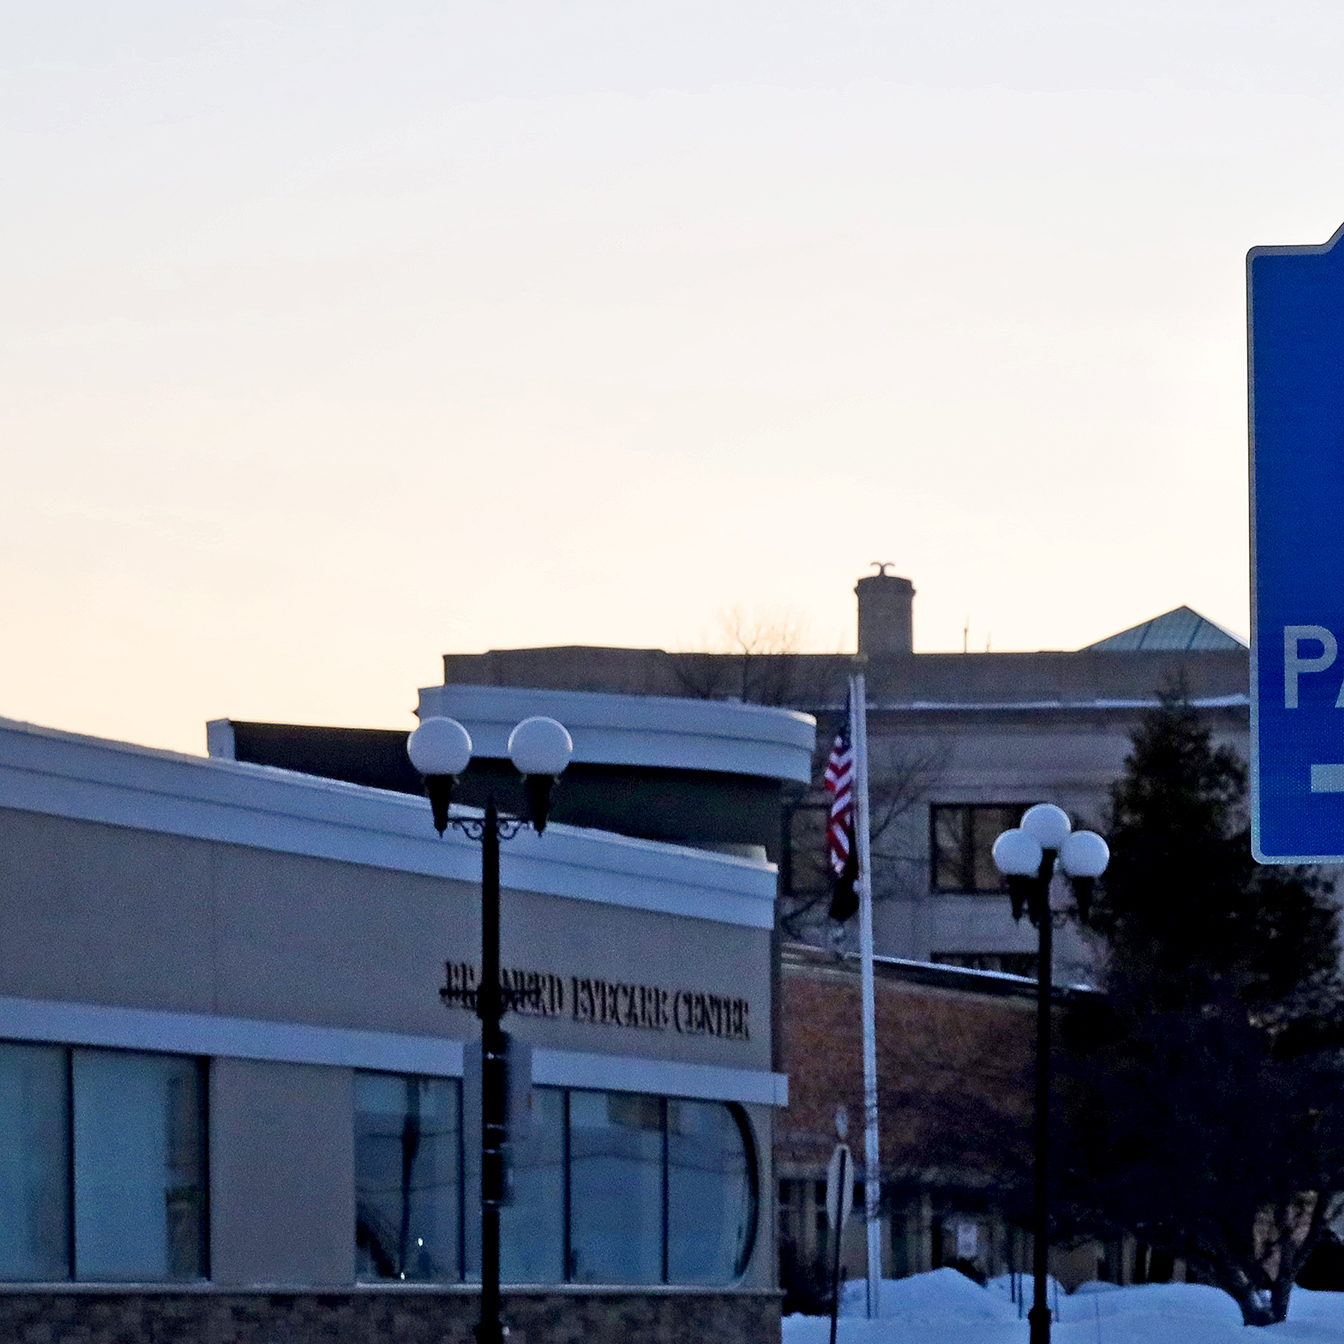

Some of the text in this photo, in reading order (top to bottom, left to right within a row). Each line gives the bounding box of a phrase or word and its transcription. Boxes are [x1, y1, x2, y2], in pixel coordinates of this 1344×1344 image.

[446, 962, 750, 1040] BRNERD EYECARE CENTER
